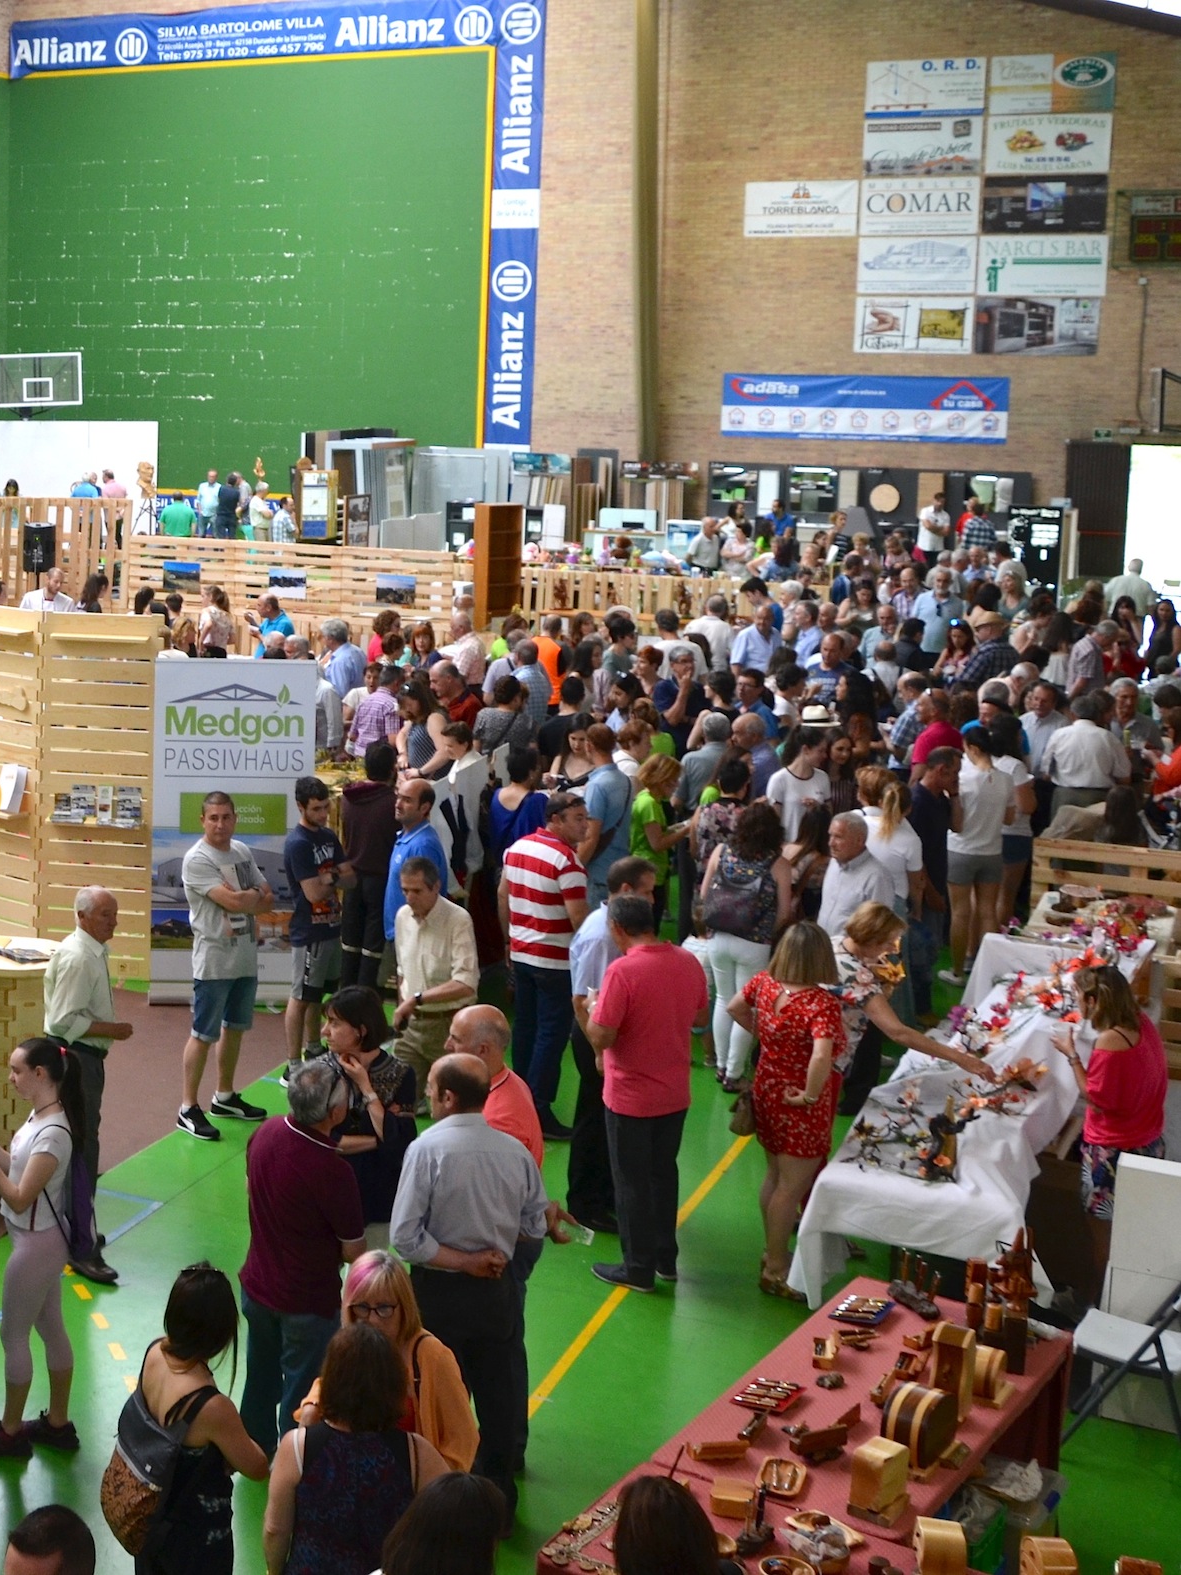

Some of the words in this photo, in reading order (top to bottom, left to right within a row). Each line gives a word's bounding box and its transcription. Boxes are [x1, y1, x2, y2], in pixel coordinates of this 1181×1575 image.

[157, 26, 196, 38] SILVIA
[201, 20, 283, 35] BARTOLOME
[286, 16, 324, 28] VILLA
[334, 14, 445, 47] Allianz
[14, 38, 106, 66] Allianz
[157, 51, 182, 61] Tels:
[183, 49, 203, 60] 975
[205, 48, 225, 59] 371
[227, 46, 249, 57] 020
[256, 44, 278, 55] 666
[280, 43, 302, 53] 457
[921, 60, 937, 72] O.
[944, 59, 959, 71] R.
[966, 58, 981, 70] D.
[501, 54, 533, 174] Allianz
[994, 118, 1034, 130] FRUTAS
[1039, 116, 1045, 125] Y
[1047, 116, 1107, 129] VERDURAS
[762, 205, 840, 215] TORREBLANCA
[867, 192, 972, 214] COMAR
[1066, 240, 1102, 256] BAR
[492, 311, 524, 430] Allianz
[743, 382, 800, 394] adasa
[943, 399, 955, 407] tu
[165, 706, 305, 745] Medgón
[164, 748, 304, 772] PASSIVHAUS
[234, 804, 262, 814] ucción
